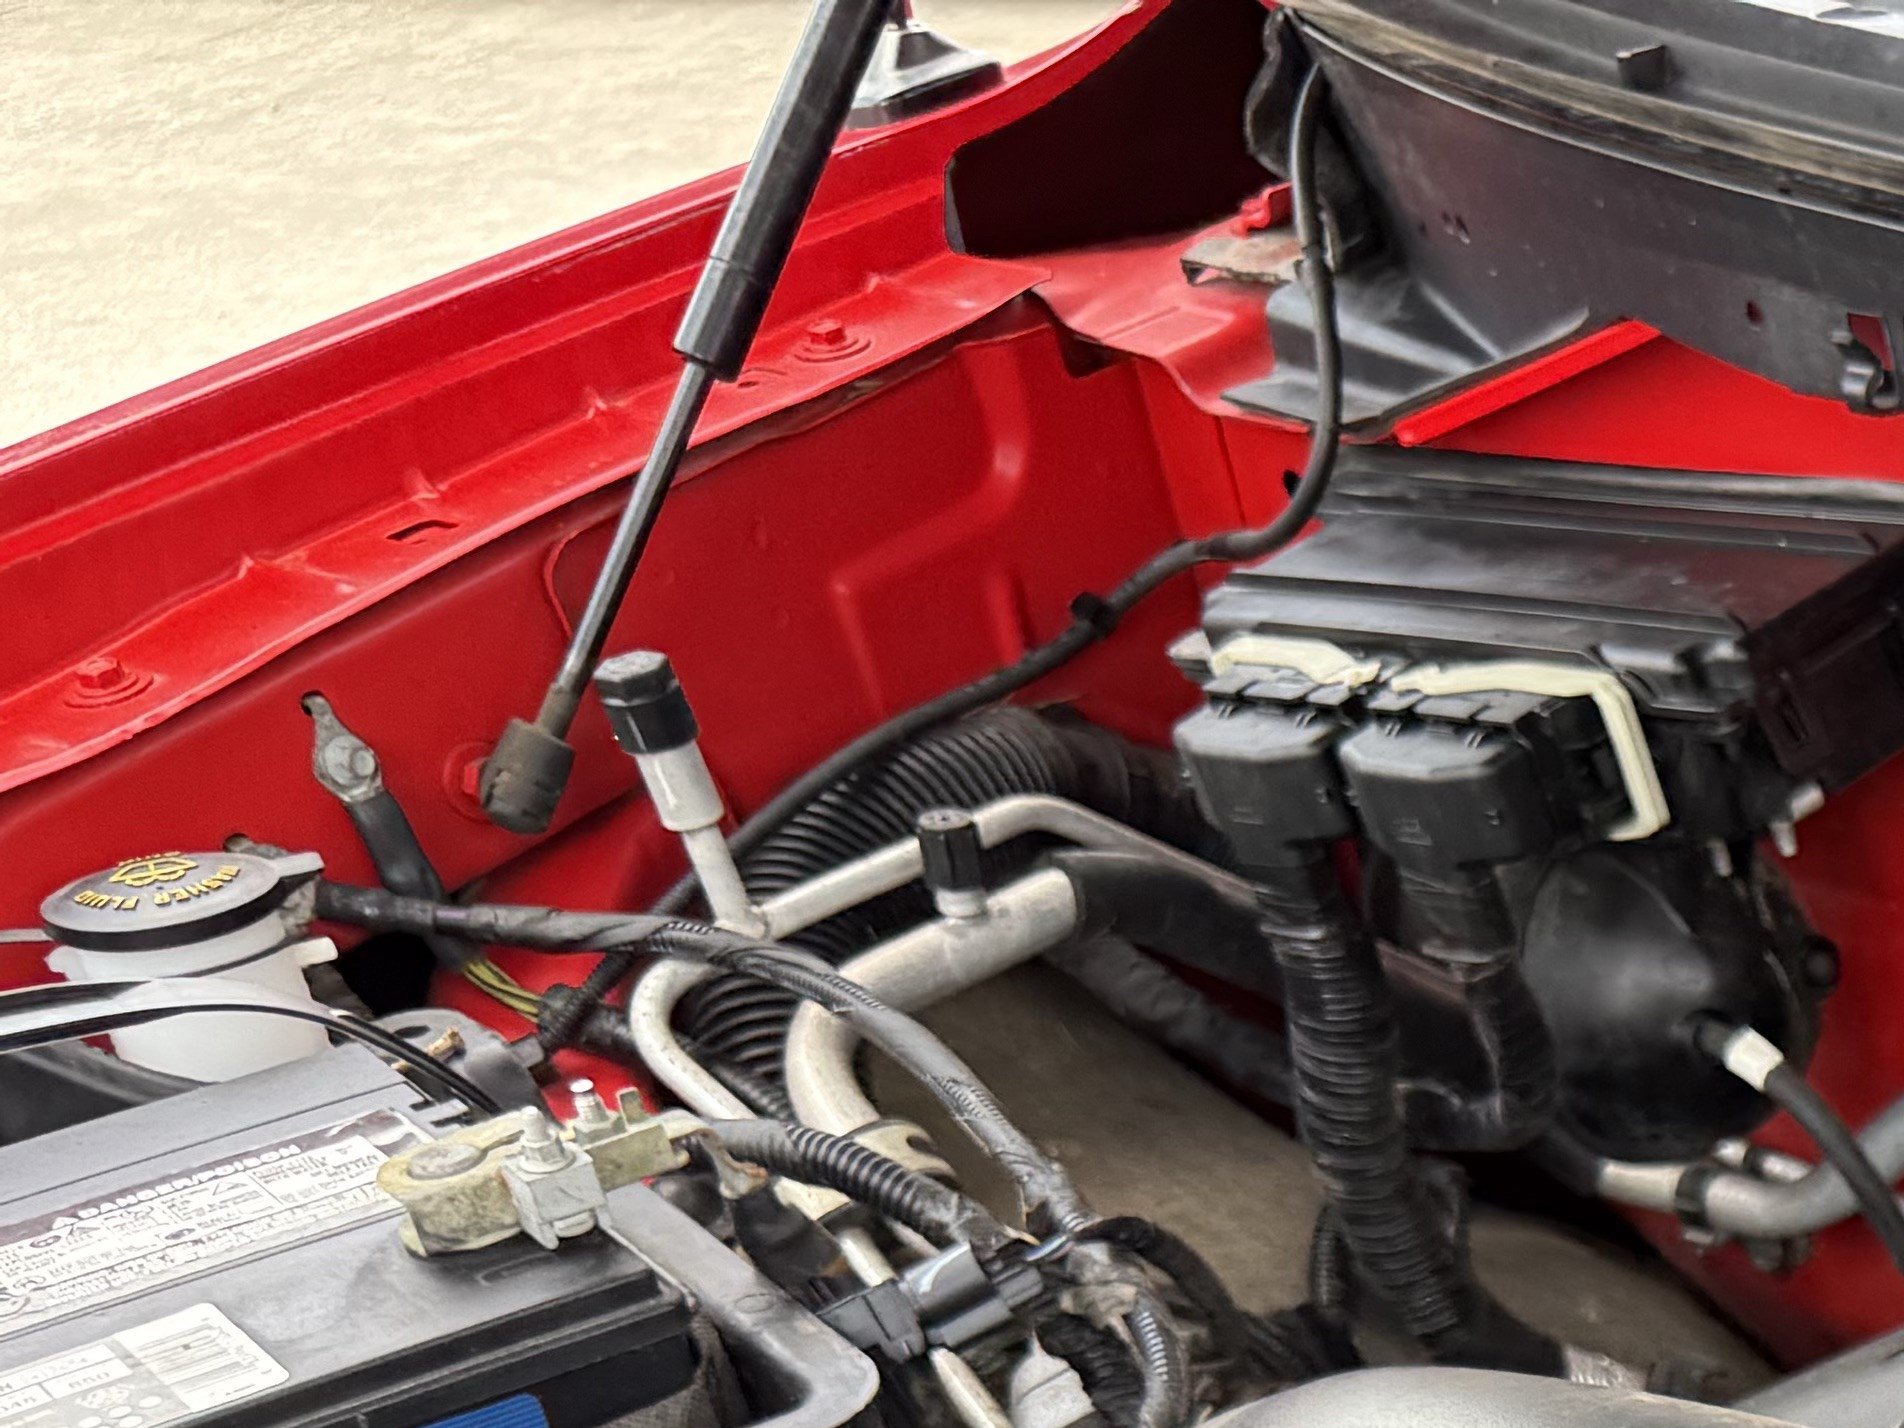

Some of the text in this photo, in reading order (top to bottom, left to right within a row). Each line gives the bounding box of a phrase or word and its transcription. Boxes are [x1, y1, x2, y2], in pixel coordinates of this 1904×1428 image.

[73, 865, 240, 911] WASHER FLUID
[77, 1145, 302, 1219] DANGER/POISON
